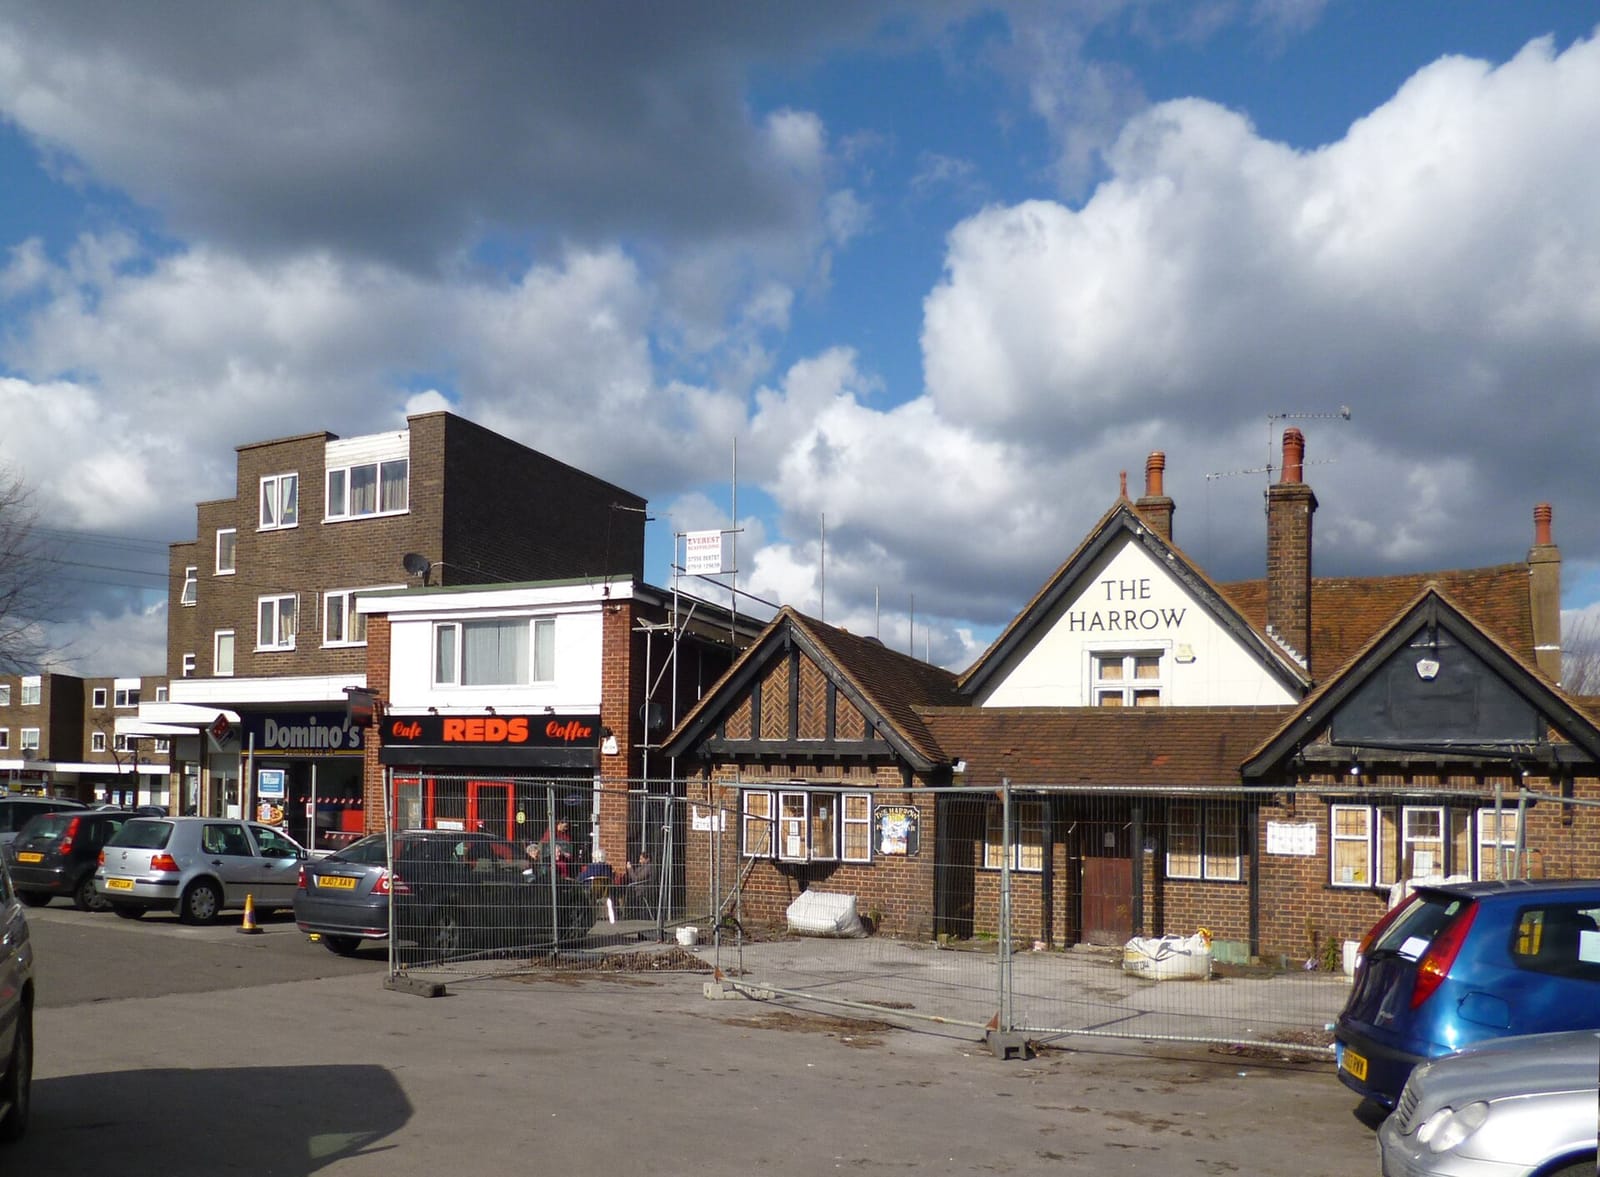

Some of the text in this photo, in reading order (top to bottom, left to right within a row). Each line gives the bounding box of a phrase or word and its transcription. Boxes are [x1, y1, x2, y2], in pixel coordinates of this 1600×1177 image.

[688, 536, 720, 545] EVEREST
[1101, 579, 1151, 600] THE
[1069, 608, 1187, 632] HARROW
[265, 716, 360, 748] Domino's
[392, 718, 592, 743] Cafe REDS Coffee
